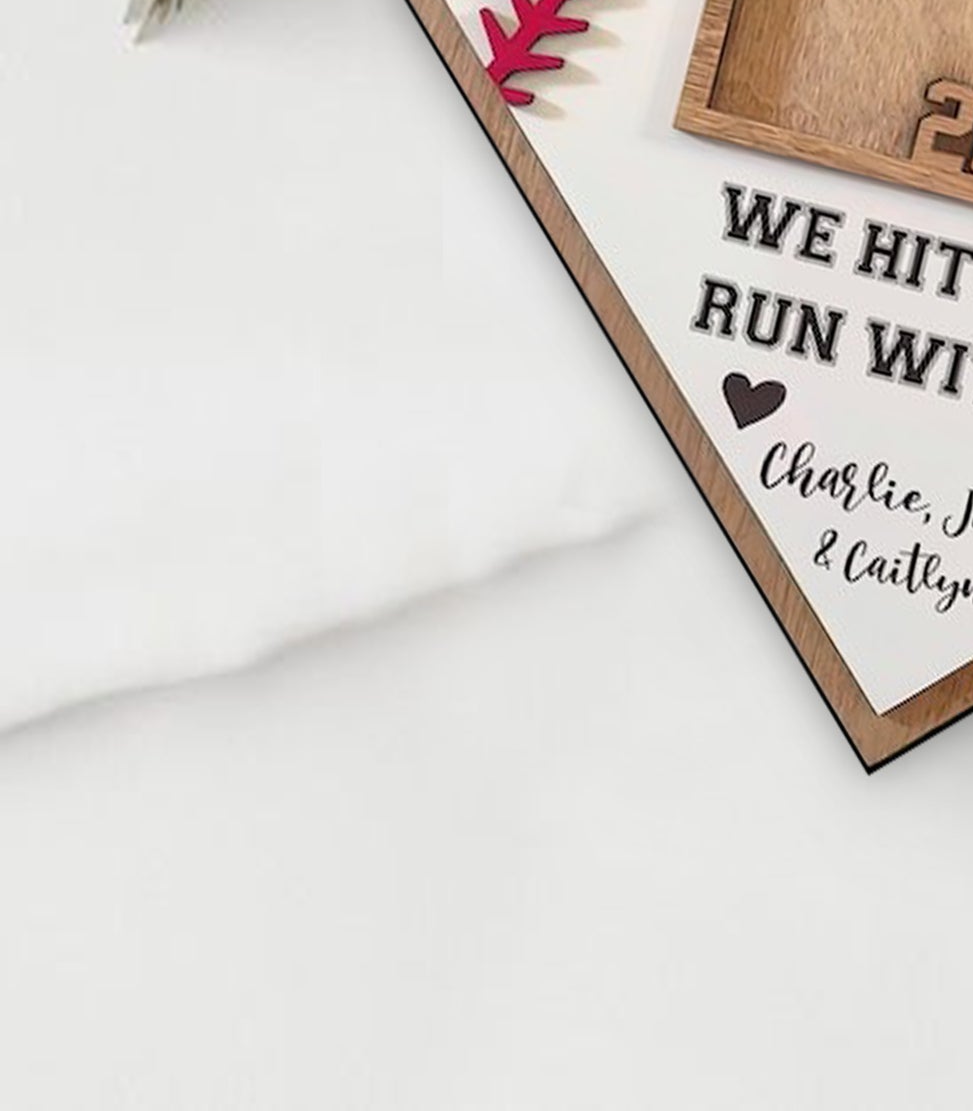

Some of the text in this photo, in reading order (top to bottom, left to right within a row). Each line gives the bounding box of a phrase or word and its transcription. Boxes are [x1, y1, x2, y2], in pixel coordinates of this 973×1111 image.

[721, 181, 845, 267] WE
[691, 273, 847, 366] RUN
[759, 440, 932, 524] Charlie,
[813, 529, 840, 569] &
